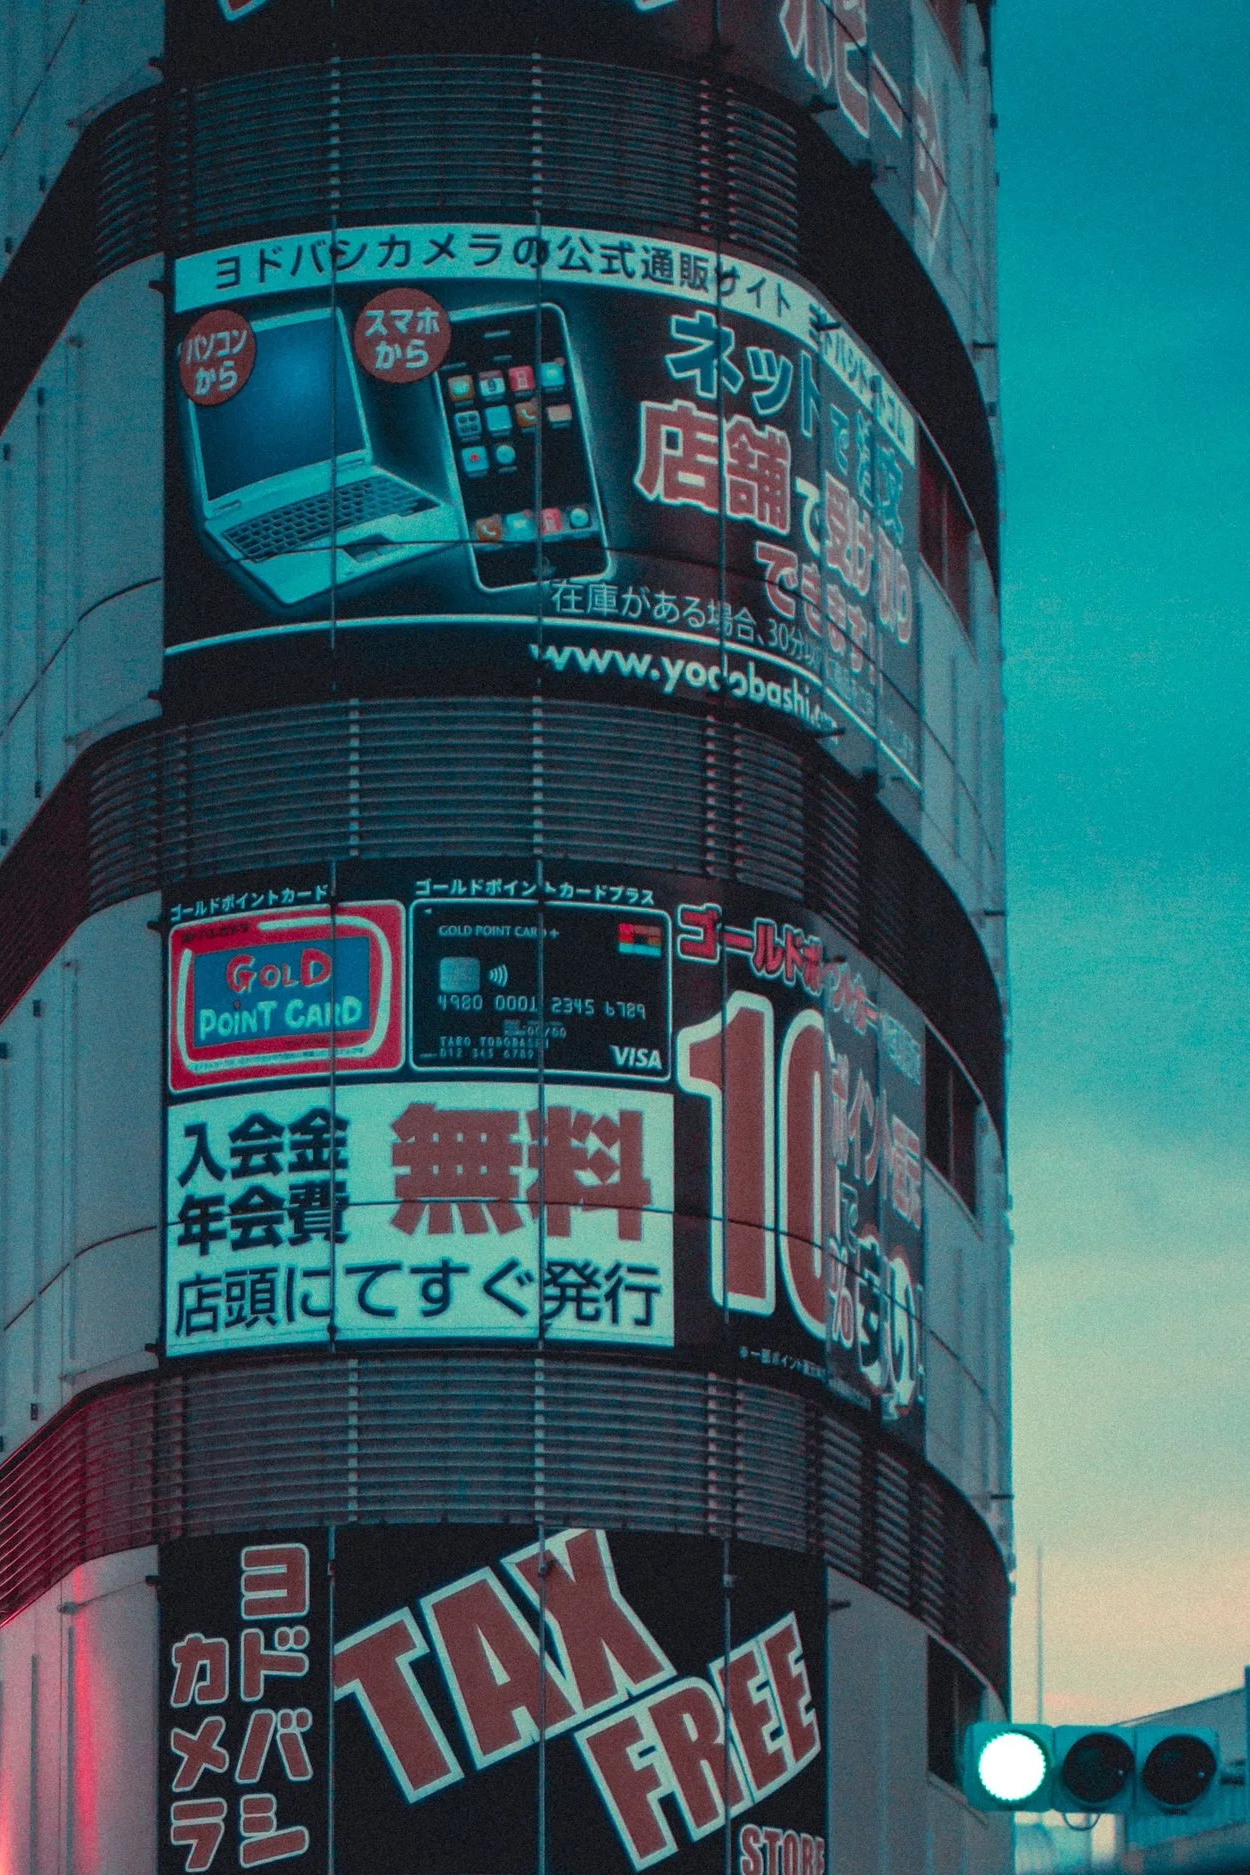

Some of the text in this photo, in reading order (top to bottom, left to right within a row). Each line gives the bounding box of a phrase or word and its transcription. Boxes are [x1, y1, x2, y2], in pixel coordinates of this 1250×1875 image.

[215, 232, 792, 318] ヨドバシカメラの公式通販サイト
[183, 327, 248, 365] パソコン
[364, 305, 440, 337] スマホ
[194, 360, 239, 396] から
[374, 339, 430, 372] から
[169, 884, 329, 922] ゴールドポイントカード
[414, 878, 655, 906] ゴールドポイントカードプラス
[284, 995, 363, 1031] CARD
[437, 994, 483, 1011] 4980
[494, 995, 538, 1011] 0001
[551, 997, 595, 1016] 2345
[609, 1044, 663, 1070] VISA
[182, 1107, 348, 1187] 入会金
[389, 1101, 653, 1243] 無料
[177, 1180, 350, 1257] 年会費
[175, 1257, 662, 1338] 店頭にてすぐ発行
[332, 1528, 678, 1804] TAX
[236, 1541, 313, 1868] ヨドバシ
[171, 1633, 230, 1873] カメラ
[574, 1609, 823, 1872] FREE
